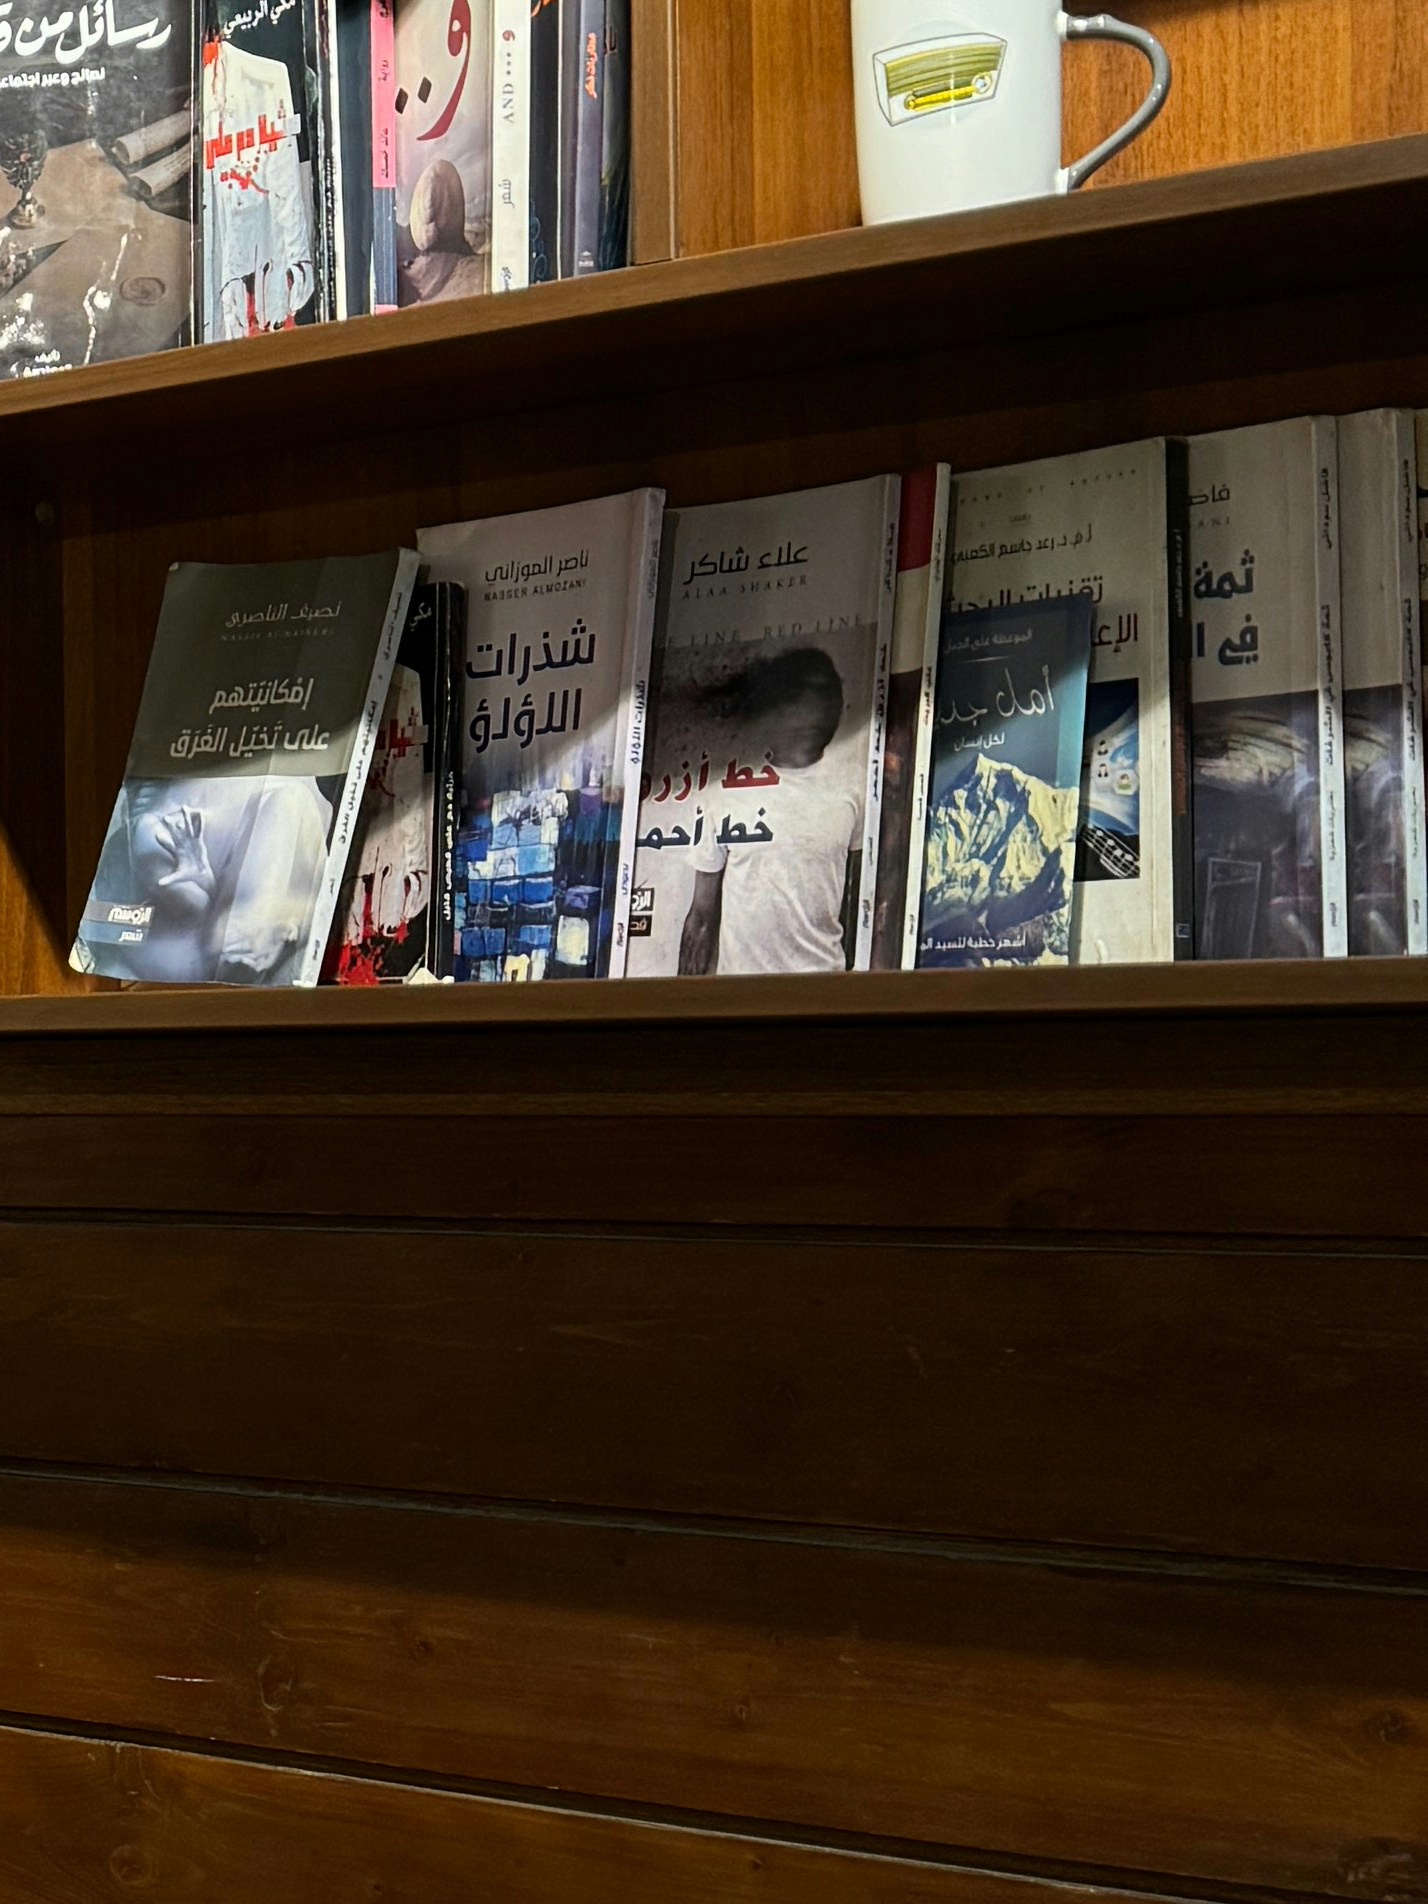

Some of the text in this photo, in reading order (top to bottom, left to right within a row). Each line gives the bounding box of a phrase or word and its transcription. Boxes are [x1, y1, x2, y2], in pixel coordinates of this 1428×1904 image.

[14, 11, 74, 56] من
[502, 82, 515, 123] AND
[485, 549, 589, 586] ناصر الموزاني
[683, 542, 808, 585] علاء شاكر
[1194, 549, 1255, 599] ثمة
[465, 618, 596, 686] شذرات
[1218, 614, 1259, 666] في
[996, 664, 1054, 717] أمل
[283, 724, 330, 751] على
[469, 688, 582, 754] اللؤلؤ
[722, 751, 780, 789] خط
[635, 806, 774, 850] خط أحم
